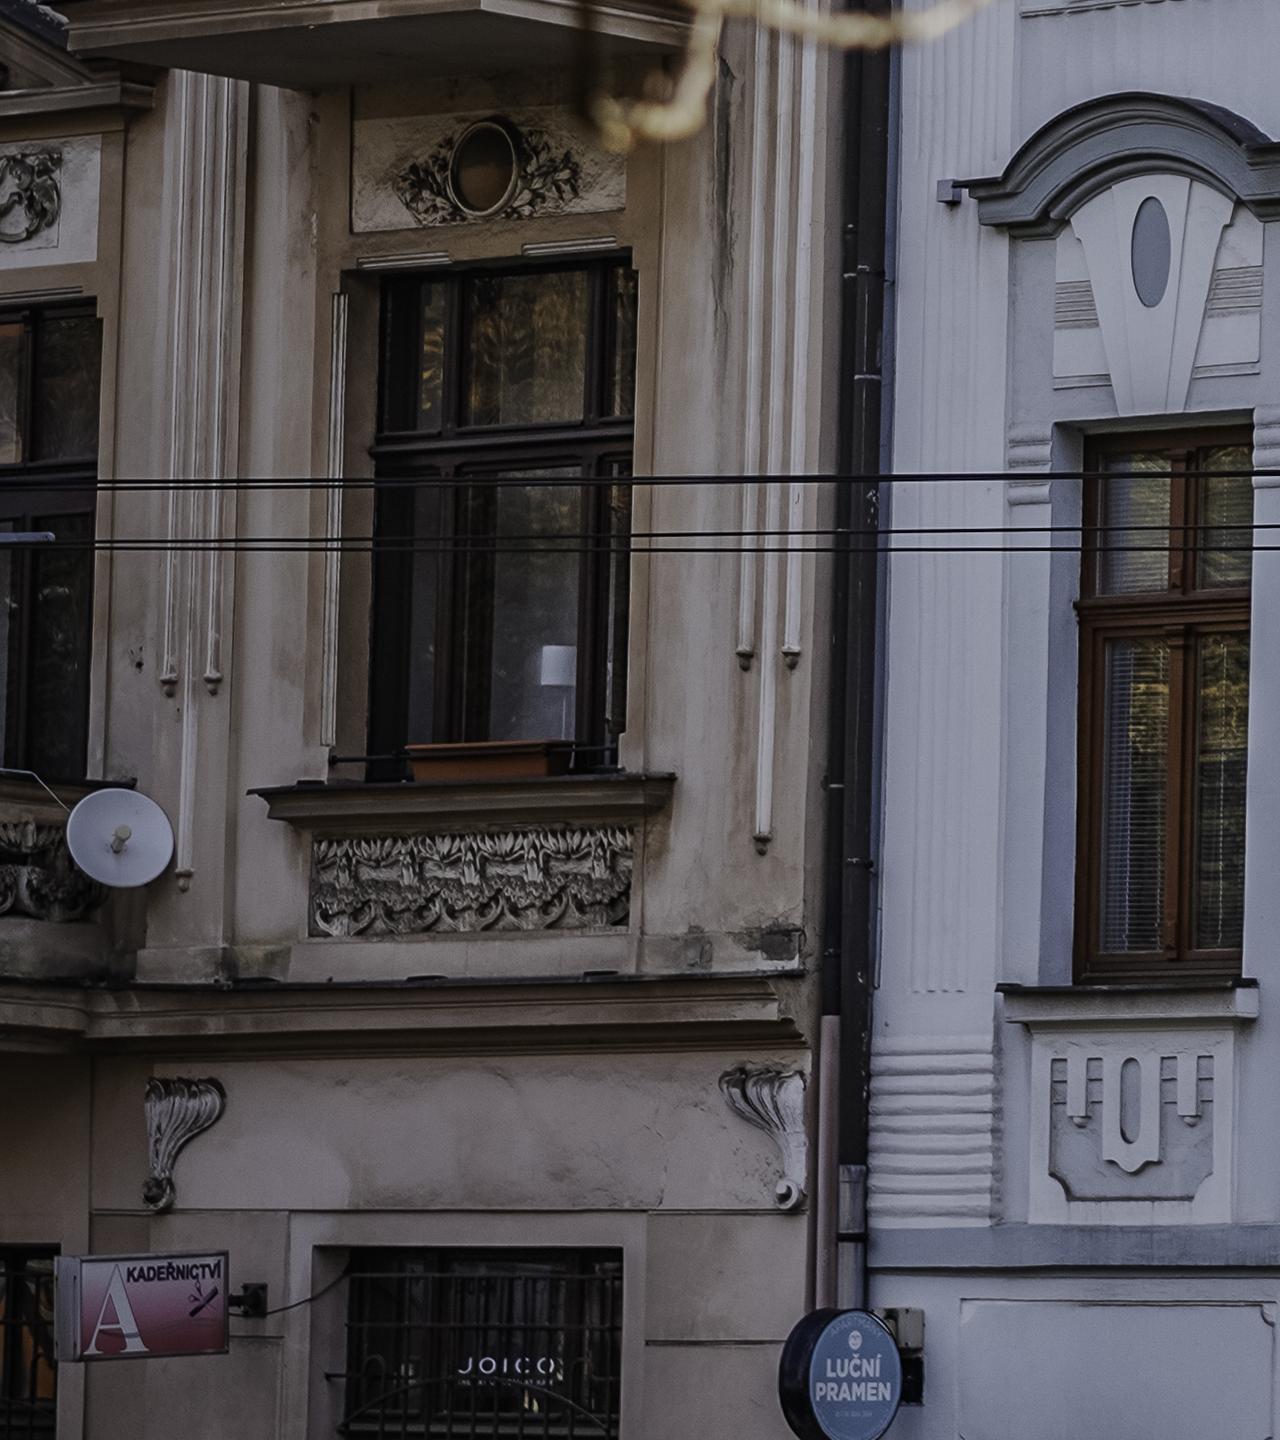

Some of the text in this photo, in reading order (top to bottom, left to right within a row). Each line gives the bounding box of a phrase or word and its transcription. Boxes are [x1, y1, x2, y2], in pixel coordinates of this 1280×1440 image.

[127, 1260, 222, 1282] KADEŘNICTVÍ
[84, 1264, 149, 1355] A
[457, 1356, 555, 1374] JOICO
[826, 1354, 881, 1377] LUČNÍ
[816, 1382, 891, 1401] PRAMEN
